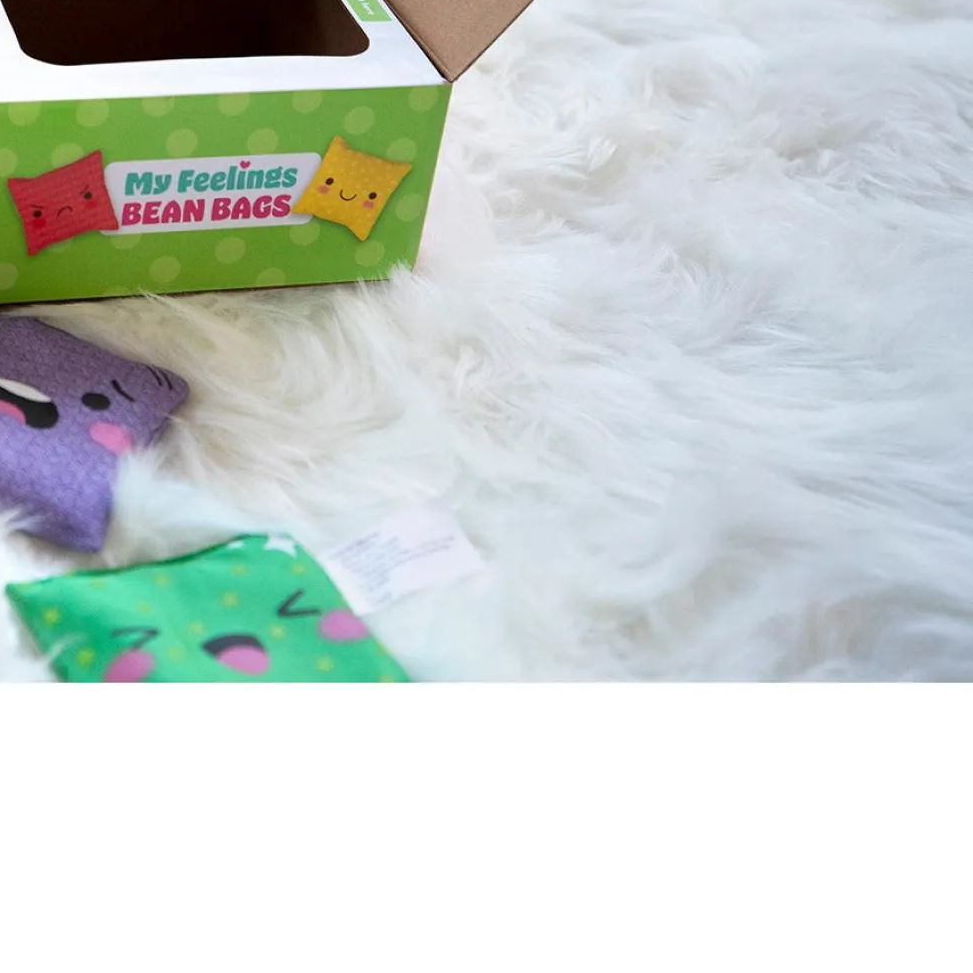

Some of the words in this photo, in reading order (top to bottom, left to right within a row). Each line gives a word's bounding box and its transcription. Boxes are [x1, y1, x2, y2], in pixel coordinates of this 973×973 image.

[124, 171, 172, 196] My
[177, 161, 298, 193] Feelings
[121, 198, 206, 226] BEAN
[211, 194, 292, 221] BAGS
